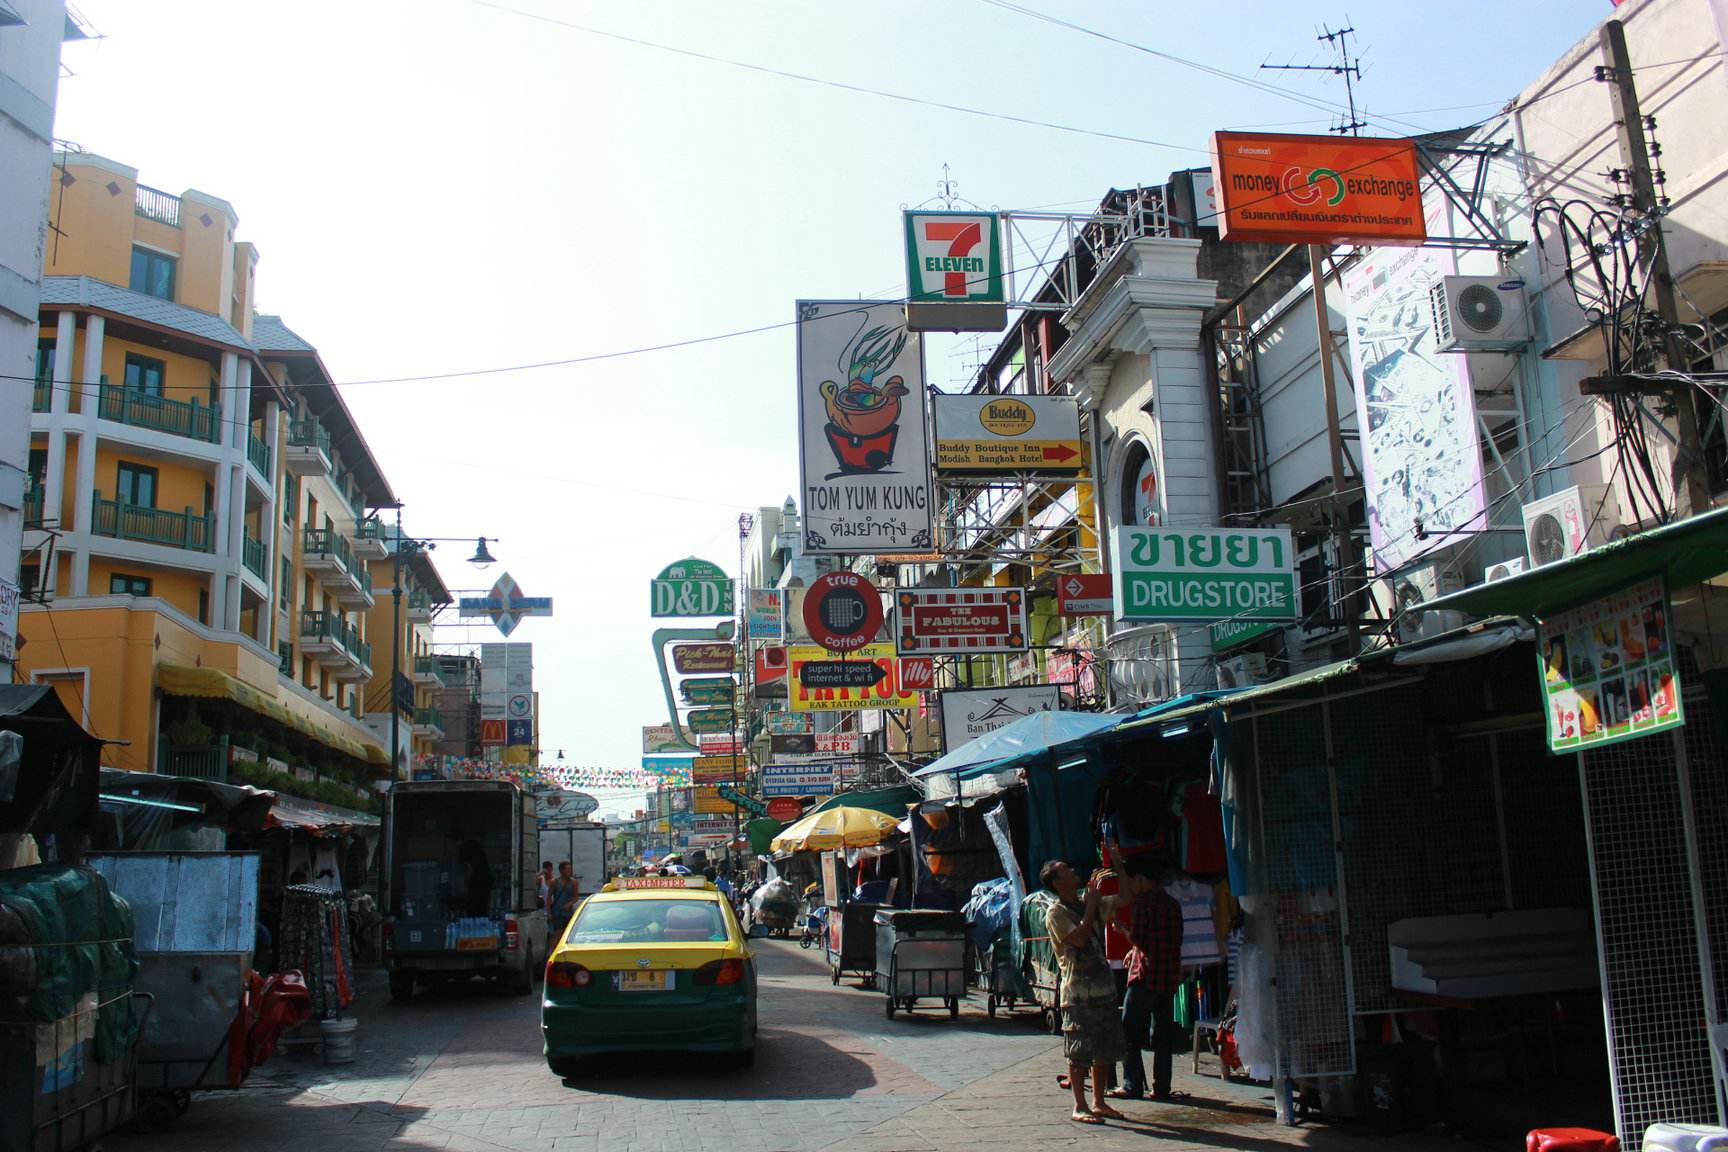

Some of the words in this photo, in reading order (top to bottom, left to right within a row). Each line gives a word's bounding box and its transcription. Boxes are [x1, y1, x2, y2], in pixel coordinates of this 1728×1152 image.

[1232, 173, 1280, 195] money
[1347, 177, 1414, 201] exchange
[925, 223, 981, 296] 7
[989, 405, 1027, 422] Buddy
[938, 443, 970, 454] Buddy
[975, 444, 1019, 455] Boutique
[1023, 444, 1040, 452] Inn
[938, 454, 971, 463] Modish
[978, 454, 1016, 465] Bangkok
[1019, 454, 1043, 463] Hotel
[808, 486, 840, 511] TOM
[845, 486, 877, 511] YUM
[883, 486, 926, 510] KUNG
[830, 516, 907, 544] ต้มยำกุ้ง
[1130, 532, 1284, 568] ขายยา
[826, 576, 859, 587] true
[655, 581, 720, 615] D&D
[1132, 580, 1286, 608] DRUGSTORE
[922, 616, 1001, 627] FABULOUS
[824, 634, 865, 648] coffee
[857, 648, 877, 656] ART
[808, 664, 832, 674] super
[844, 663, 871, 674] speed
[903, 661, 932, 685] illy
[808, 673, 842, 682] internet
[844, 673, 850, 682] &
[809, 701, 828, 709] EAK
[831, 700, 866, 708] TATTOO
[869, 699, 900, 707] GROUP
[967, 724, 984, 733] Ban
[766, 766, 830, 774] INTERNET
